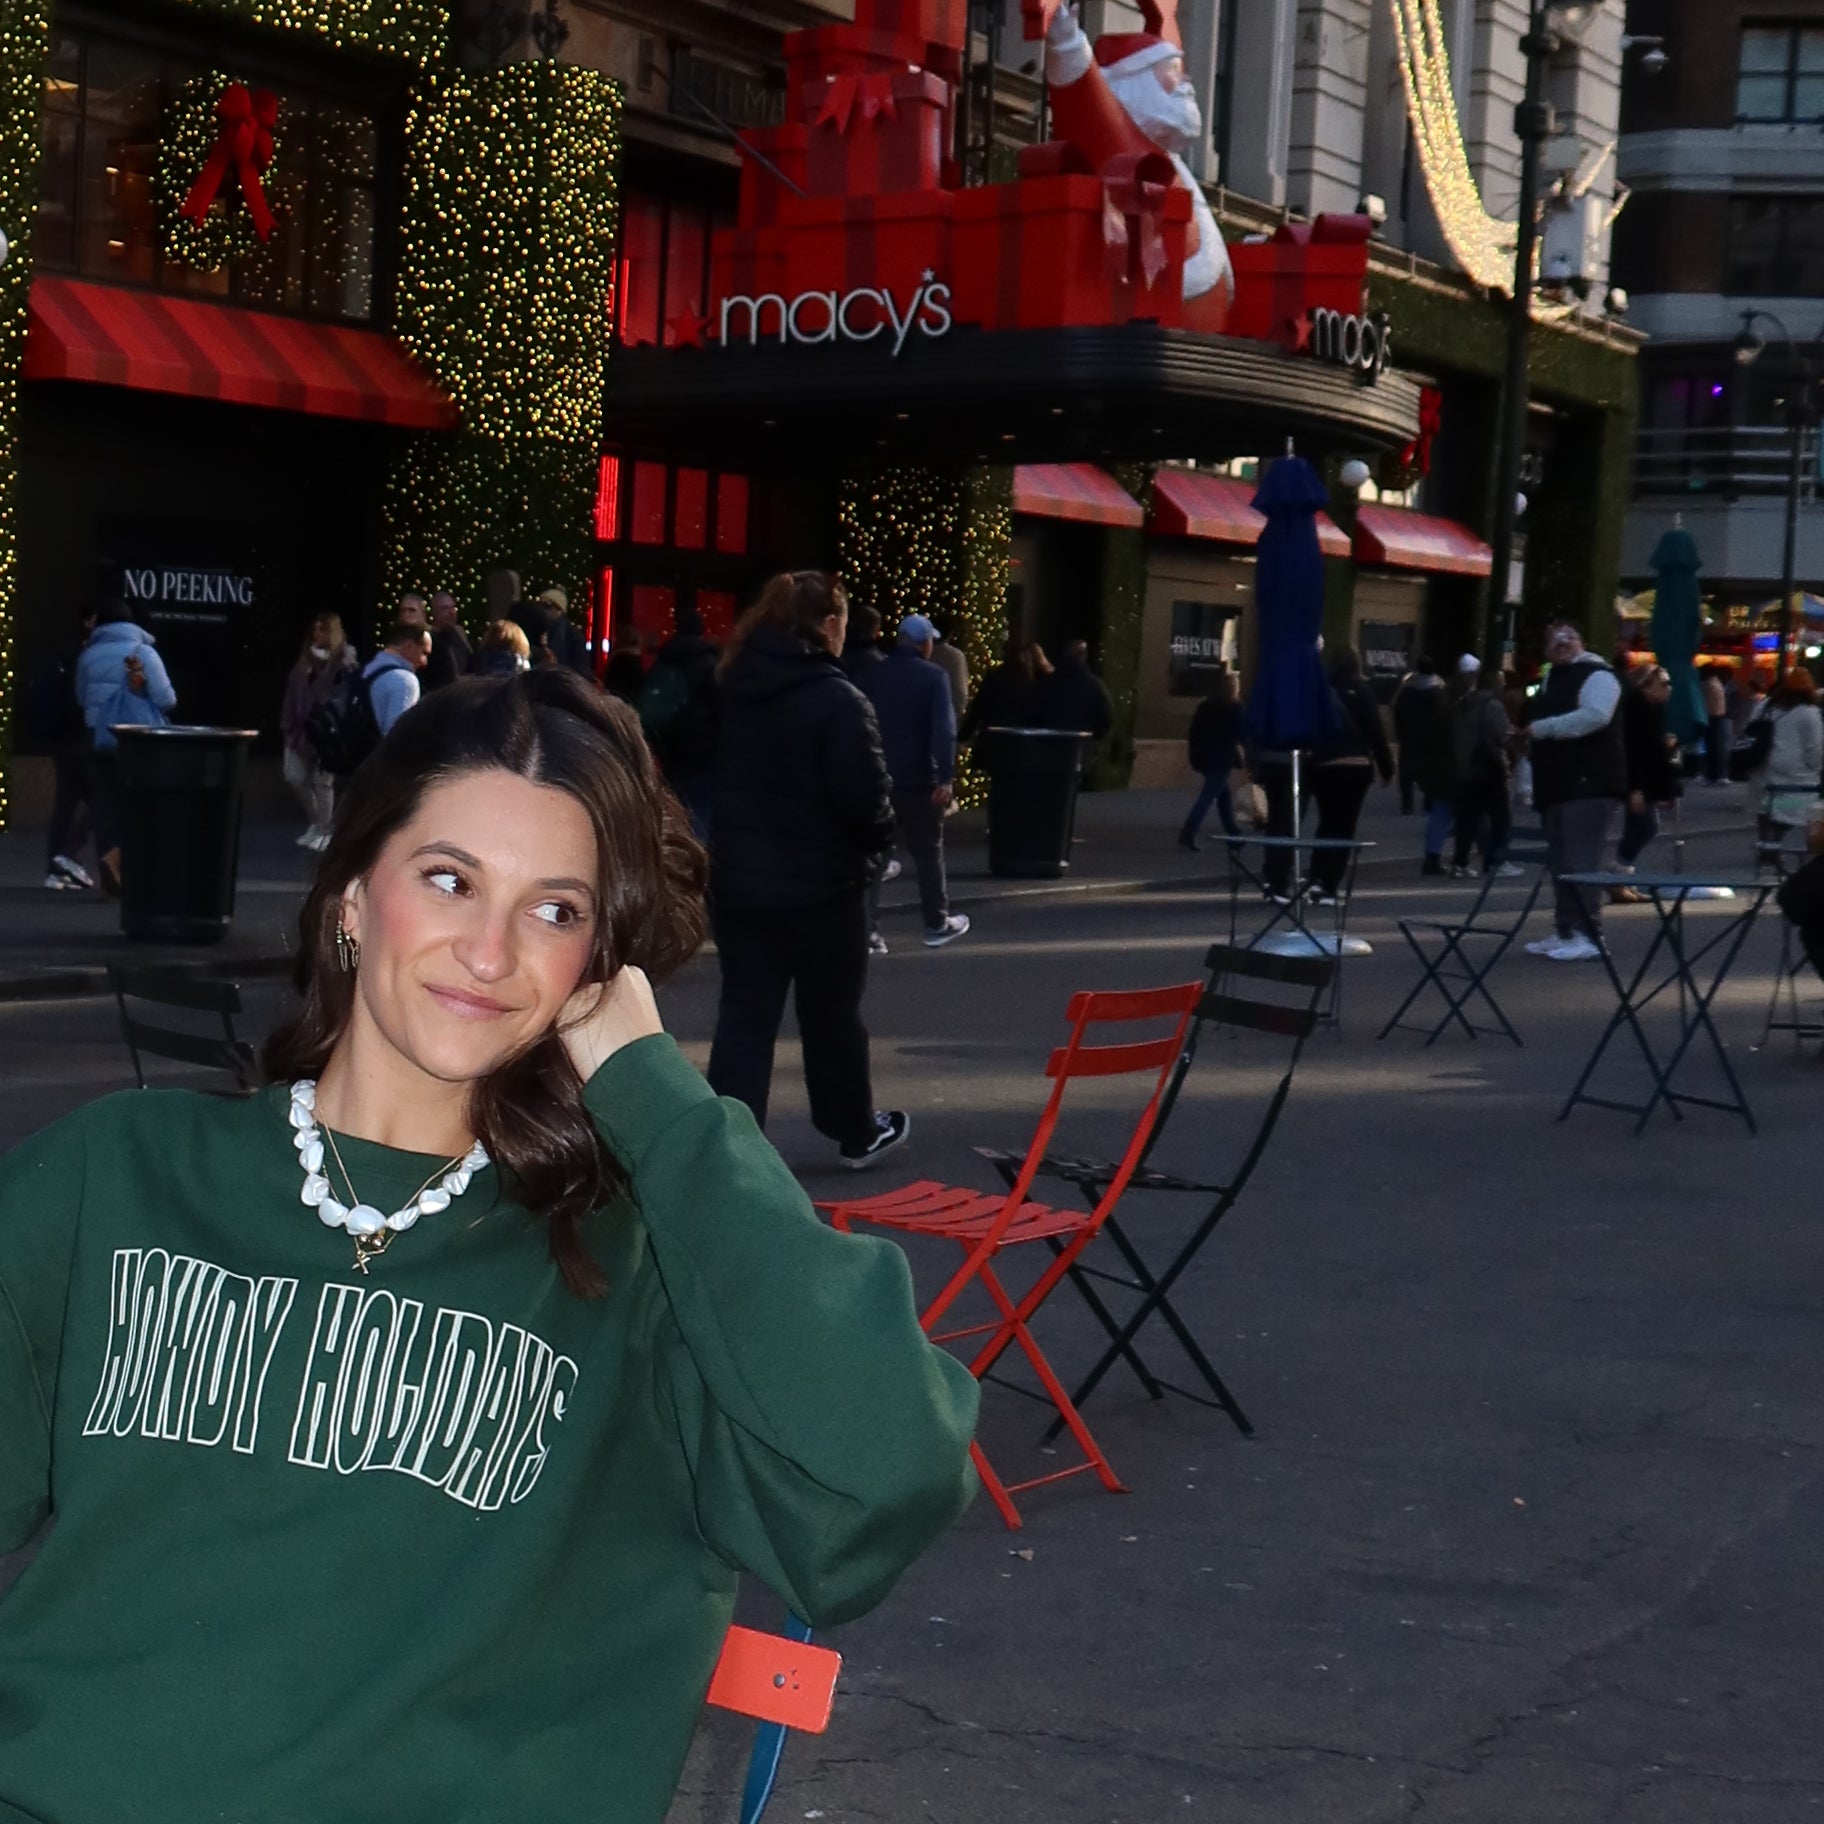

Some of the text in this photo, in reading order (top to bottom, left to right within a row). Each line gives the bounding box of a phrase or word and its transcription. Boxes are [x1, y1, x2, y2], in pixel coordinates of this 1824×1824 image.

[721, 268, 952, 357] macy's
[123, 568, 254, 607] NO PEEKING
[81, 1248, 580, 1512] HOWDY HOLIDAYS
